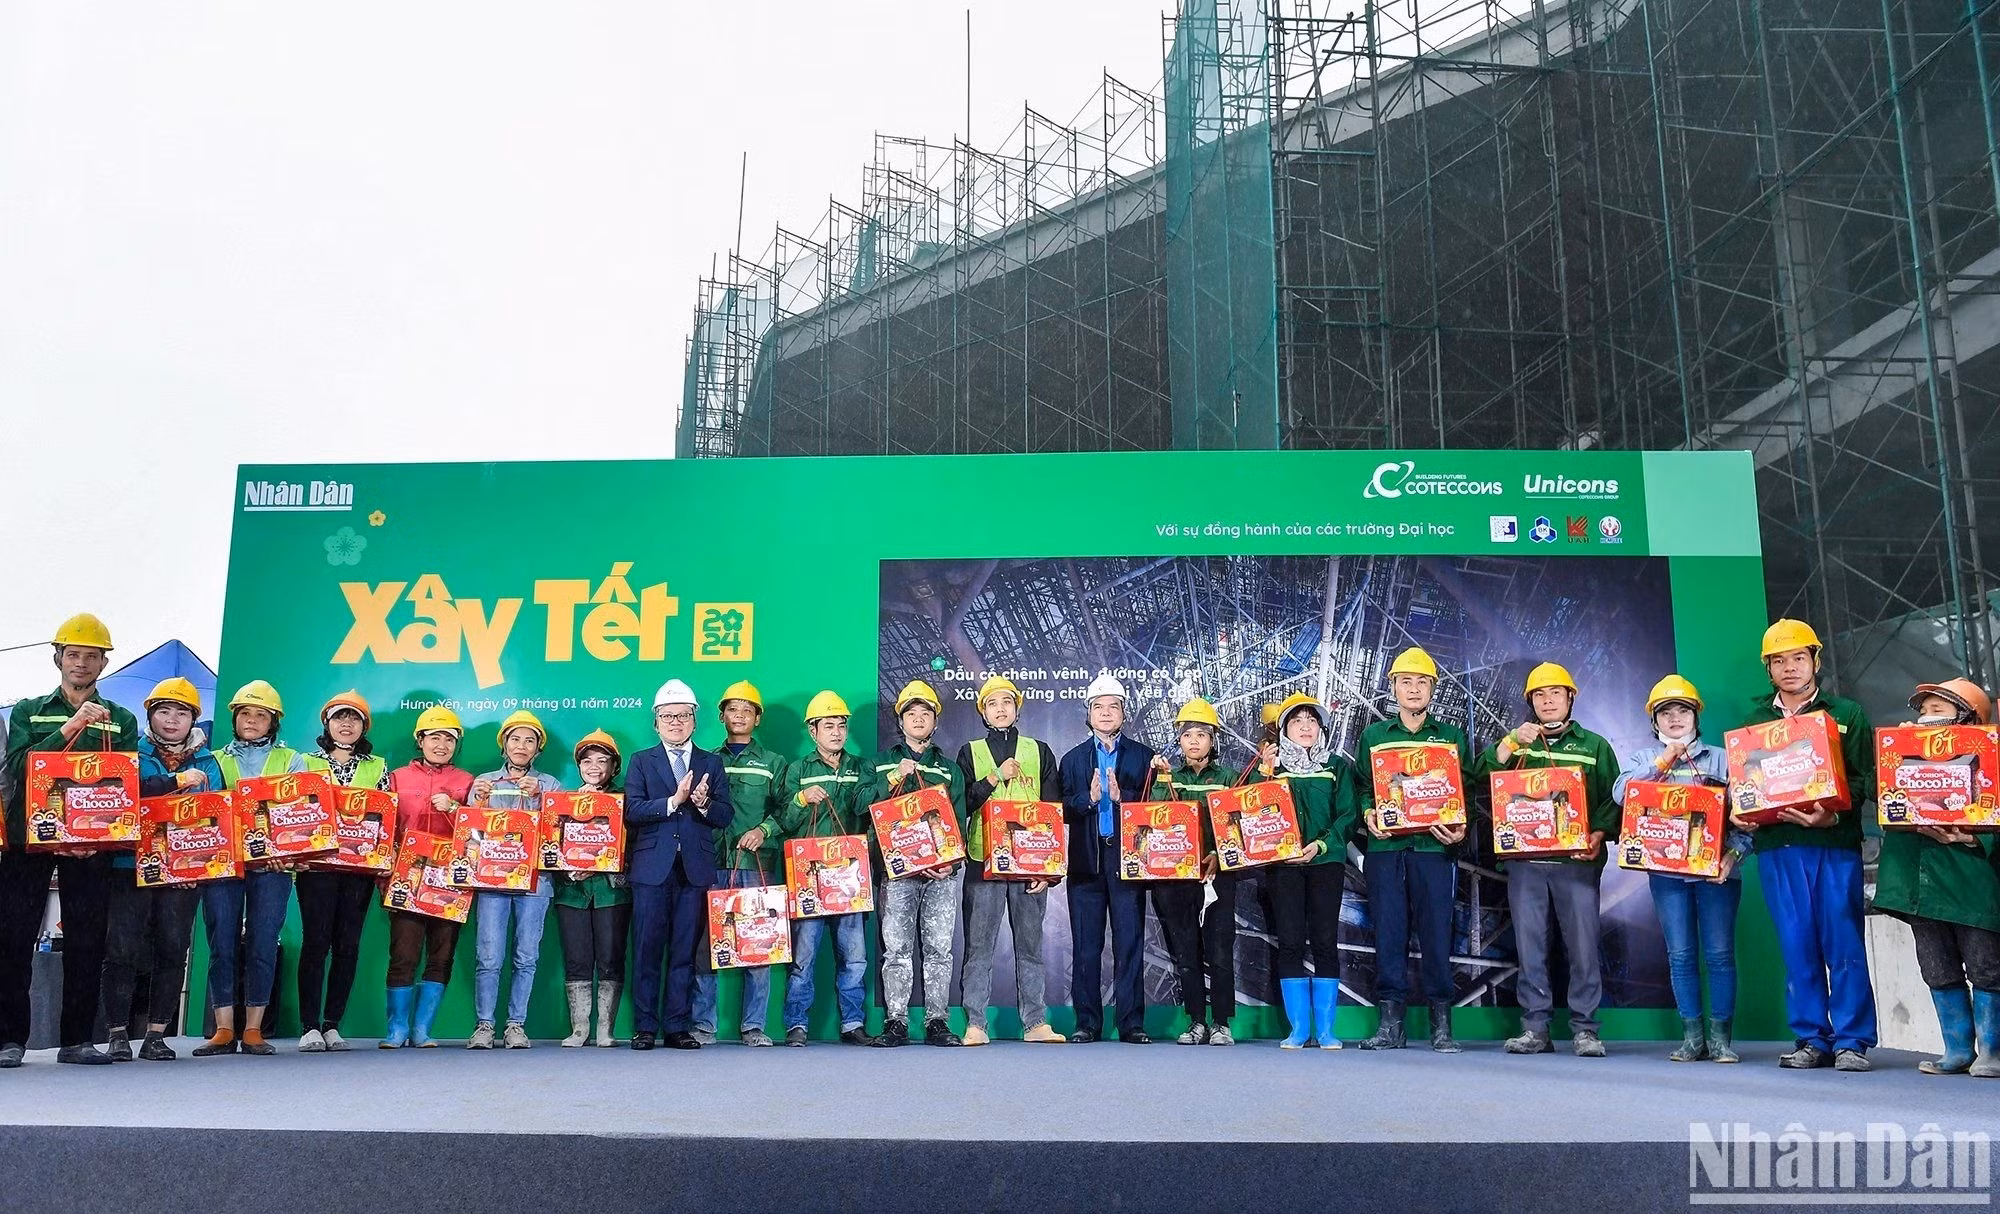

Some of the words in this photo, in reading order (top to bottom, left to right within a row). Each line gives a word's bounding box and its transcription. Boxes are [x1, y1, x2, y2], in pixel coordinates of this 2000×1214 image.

[244, 480, 304, 506] Nhân
[309, 480, 354, 505] Dân
[1524, 474, 1619, 494] Unicons
[1156, 523, 1179, 537] Với
[1183, 525, 1199, 539] sự
[1203, 521, 1241, 539] đồng
[1245, 523, 1281, 536] hành
[1285, 521, 1312, 536] của
[1316, 523, 1342, 536] các
[1346, 521, 1395, 539] trường
[1399, 522, 1424, 538] Đại
[1428, 522, 1455, 538] học
[330, 574, 523, 689] Xây
[534, 561, 679, 662] Tết
[944, 665, 975, 681] Dẫu
[979, 668, 998, 681] có
[1001, 667, 1048, 681] chênh
[1052, 667, 1093, 681] vênh,
[1151, 666, 1170, 679] có
[467, 698, 499, 711] ngày
[502, 699, 518, 709] 09
[522, 698, 559, 711] tháng
[562, 699, 577, 709] 01
[581, 698, 608, 709] năm
[612, 698, 643, 709] 2024
[1018, 686, 1055, 703] vững
[1060, 686, 1088, 700] chã
[1755, 720, 1792, 749] Tết
[1915, 728, 1958, 758] Tết
[66, 754, 106, 779] Tết
[1398, 749, 1430, 774] Tết
[1767, 758, 1811, 779] ChocoP
[268, 774, 300, 800] Tết
[1406, 786, 1447, 798] ChocoP
[1519, 771, 1551, 794] Tết
[71, 798, 122, 809] ChocoP
[341, 789, 369, 811] Tết
[569, 793, 598, 816] Tết
[894, 794, 922, 818] Tết
[1233, 785, 1263, 811] Tết
[1655, 787, 1692, 810] Tết
[168, 796, 201, 822] Tết
[273, 812, 322, 826] ChocoPi
[1014, 802, 1040, 822] Tết
[1144, 804, 1173, 826] Tết
[1506, 810, 1549, 823] hocoPie
[482, 811, 512, 832] Tết
[1245, 821, 1282, 836] ChocoP
[338, 828, 374, 839] ocoPie
[1637, 825, 1684, 840] hocoPie
[171, 837, 218, 851] ChocoP
[816, 838, 844, 861] Tết
[1018, 840, 1053, 848] ChocoP
[1150, 842, 1186, 851] ChocoP
[482, 850, 521, 861] ChocoP
